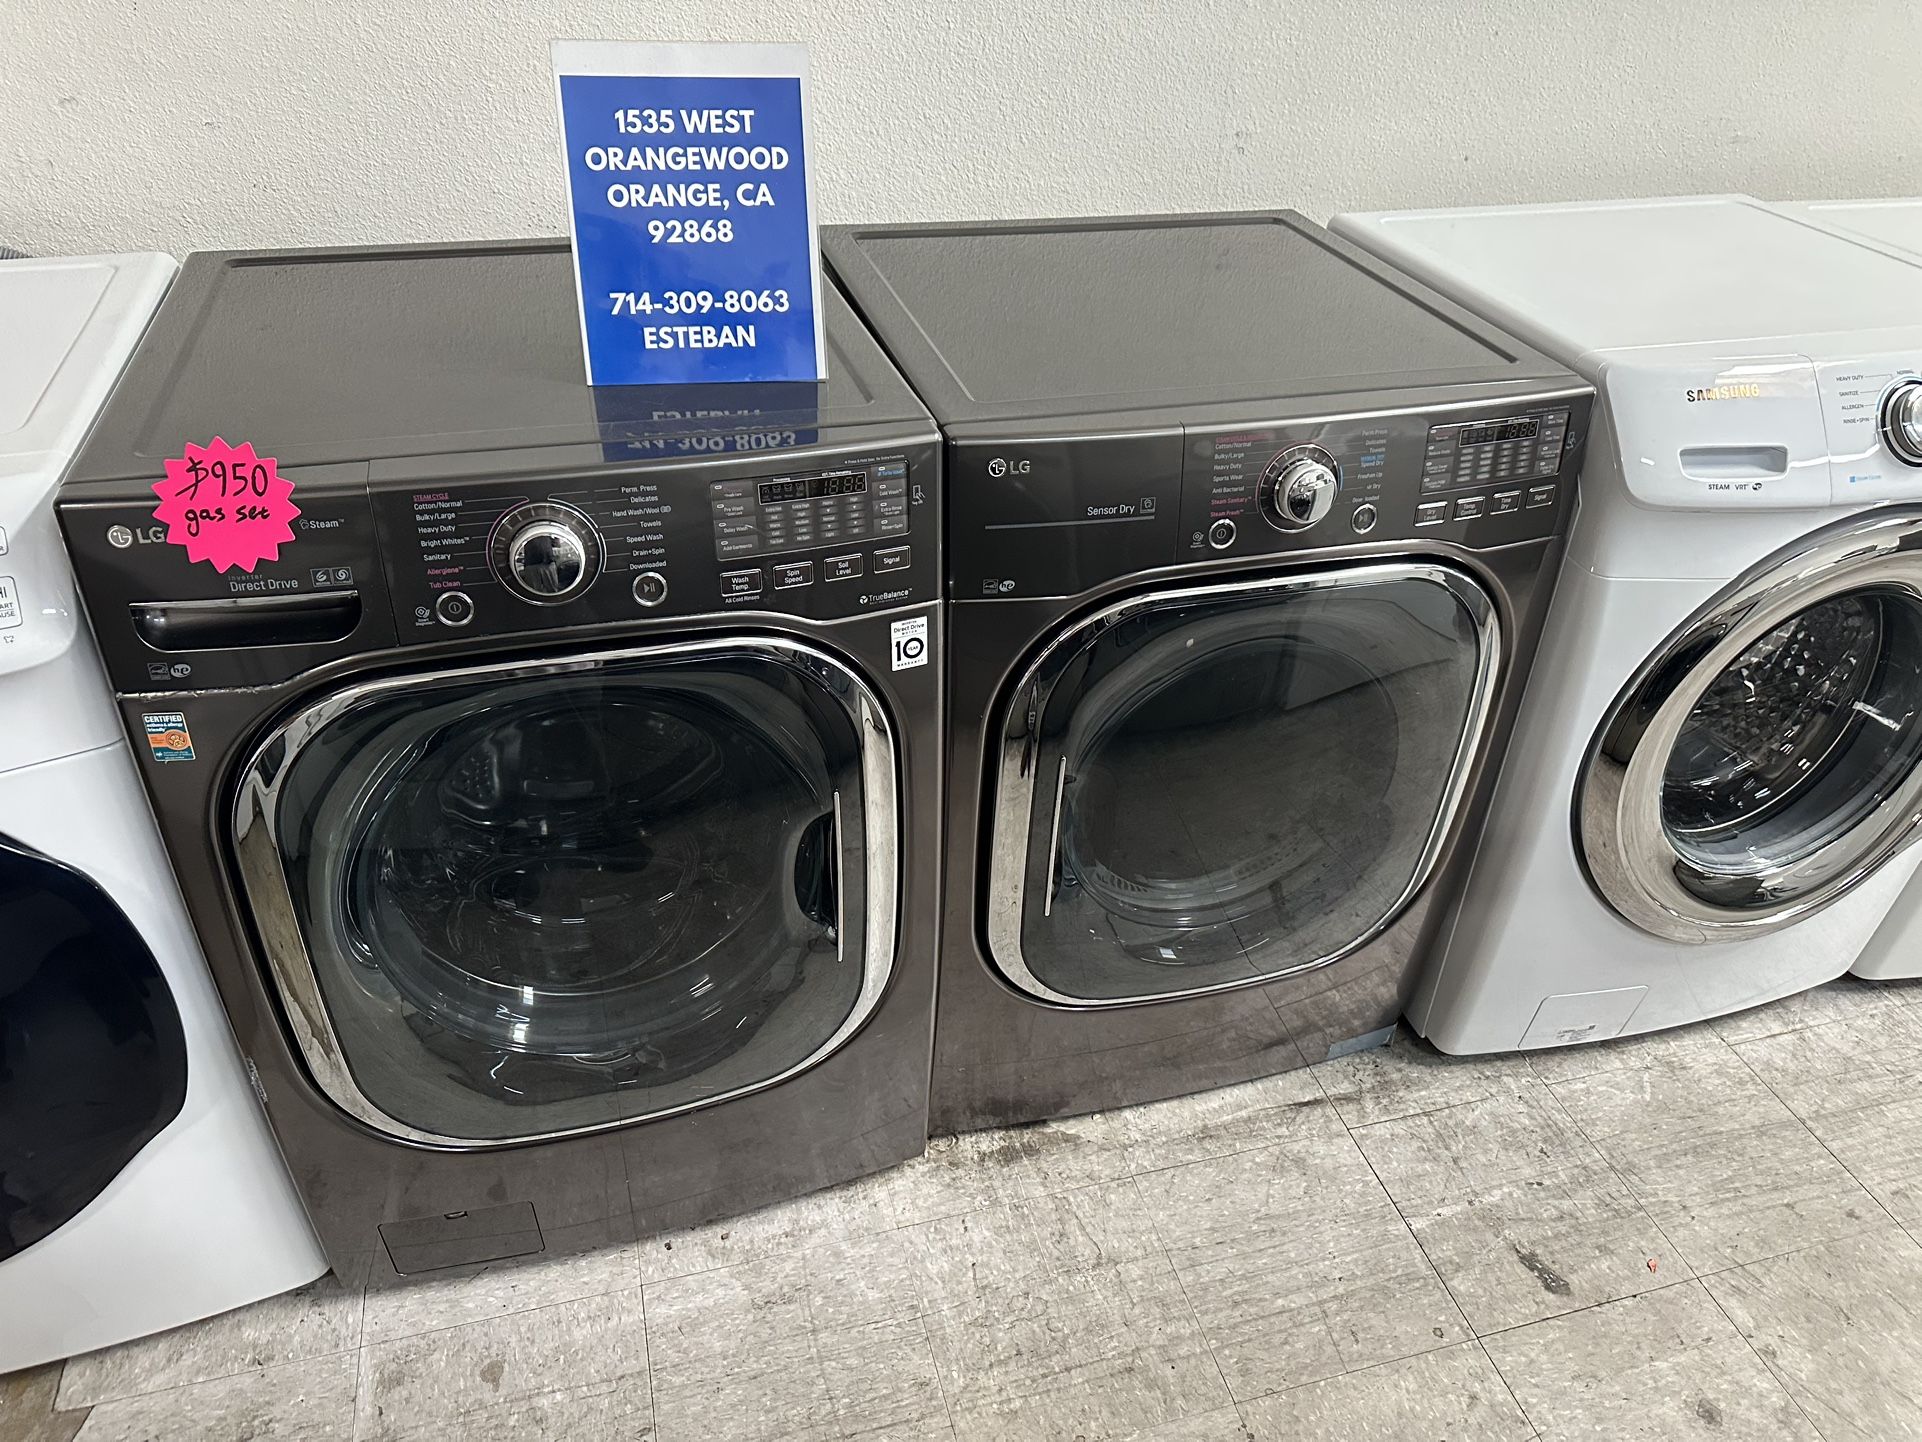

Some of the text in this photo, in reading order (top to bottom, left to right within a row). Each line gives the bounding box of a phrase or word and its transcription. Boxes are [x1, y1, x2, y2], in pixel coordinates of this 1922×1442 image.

[614, 109, 754, 134] 1535 WEST
[584, 146, 789, 171] ORANGEWOOD
[606, 182, 775, 211] ORANGE, CA
[647, 219, 734, 244] 92868
[609, 289, 790, 316] 714-309-8063
[643, 325, 756, 350] ESTEBAN
[1686, 383, 1760, 402] SAMSUNG
[1009, 460, 1030, 475] LG
[175, 456, 269, 501] $950
[1708, 483, 1730, 491] STEAM
[414, 500, 462, 510] Cotton/Normal
[630, 495, 658, 503] Delicates
[627, 507, 660, 516] Wash/Wool
[1087, 503, 1135, 516] Sensor Dry
[184, 505, 271, 538] gas set
[416, 512, 455, 521] Bulky/Large
[135, 526, 166, 545] LG
[418, 525, 456, 534] Heavy Duty
[421, 539, 441, 548] Bright
[626, 535, 645, 543] Speed
[423, 553, 451, 562] Sanitary
[883, 556, 900, 565] Signal
[629, 560, 667, 570] Downloaded
[230, 578, 299, 592] Direct Drive
[895, 637, 924, 662] 10
[144, 715, 183, 723] CERTIFIED
